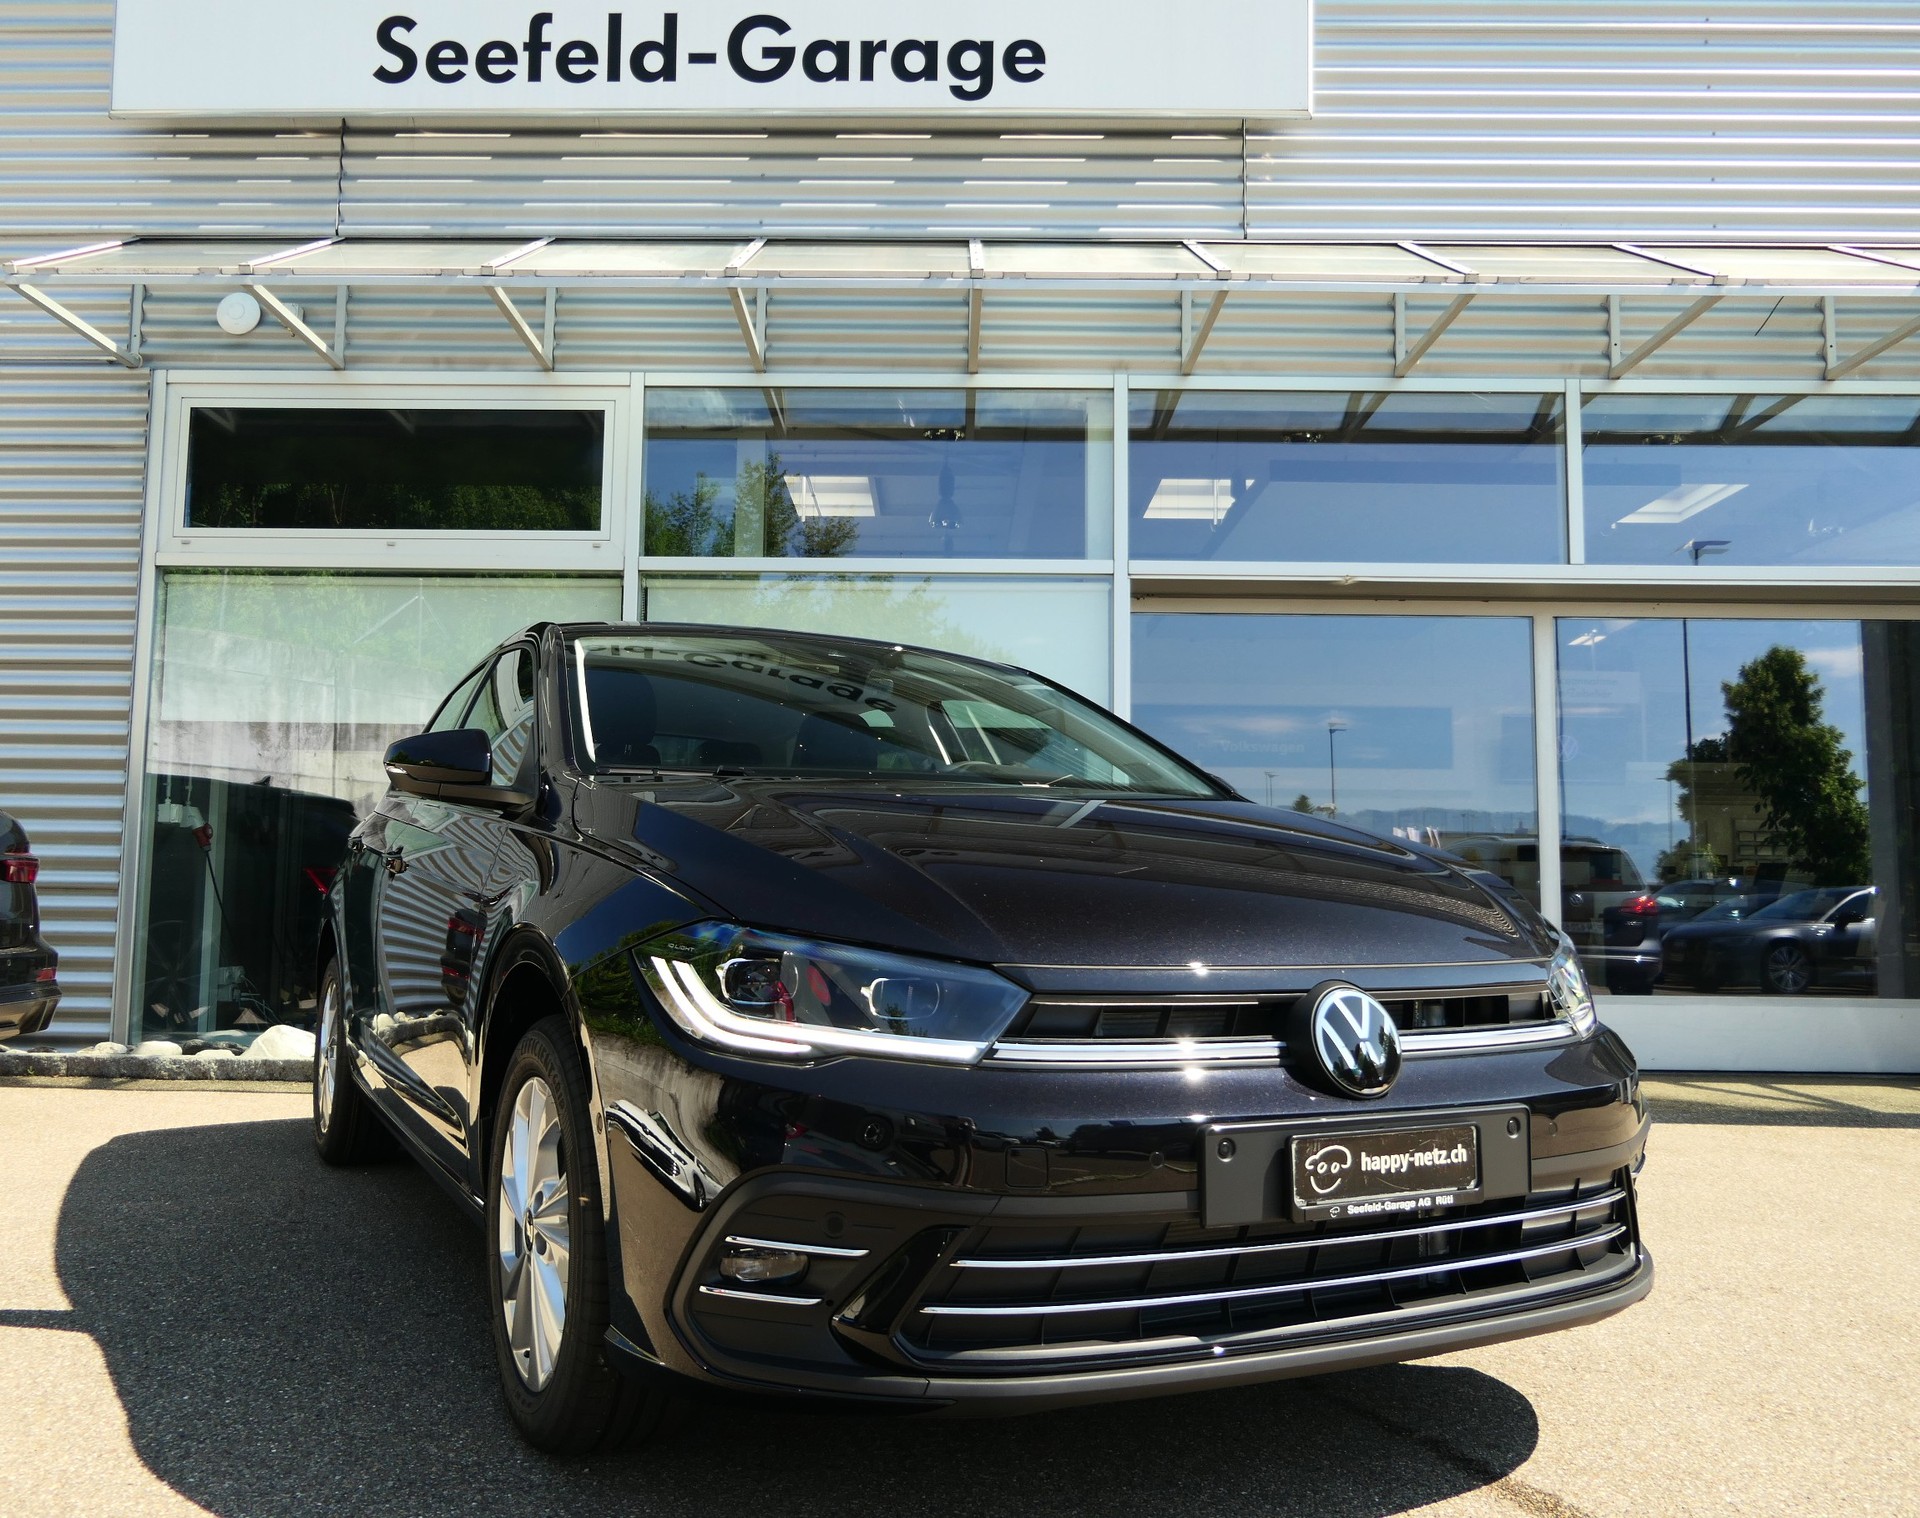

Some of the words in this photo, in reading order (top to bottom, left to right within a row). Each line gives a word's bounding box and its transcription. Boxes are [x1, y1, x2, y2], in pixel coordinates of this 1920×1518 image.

[372, 12, 1046, 102] Seefeld-Garage
[1360, 1143, 1468, 1175] happy-netz.ch
[1346, 1199, 1417, 1215] Seefeld-Garage
[1417, 1197, 1432, 1208] AG
